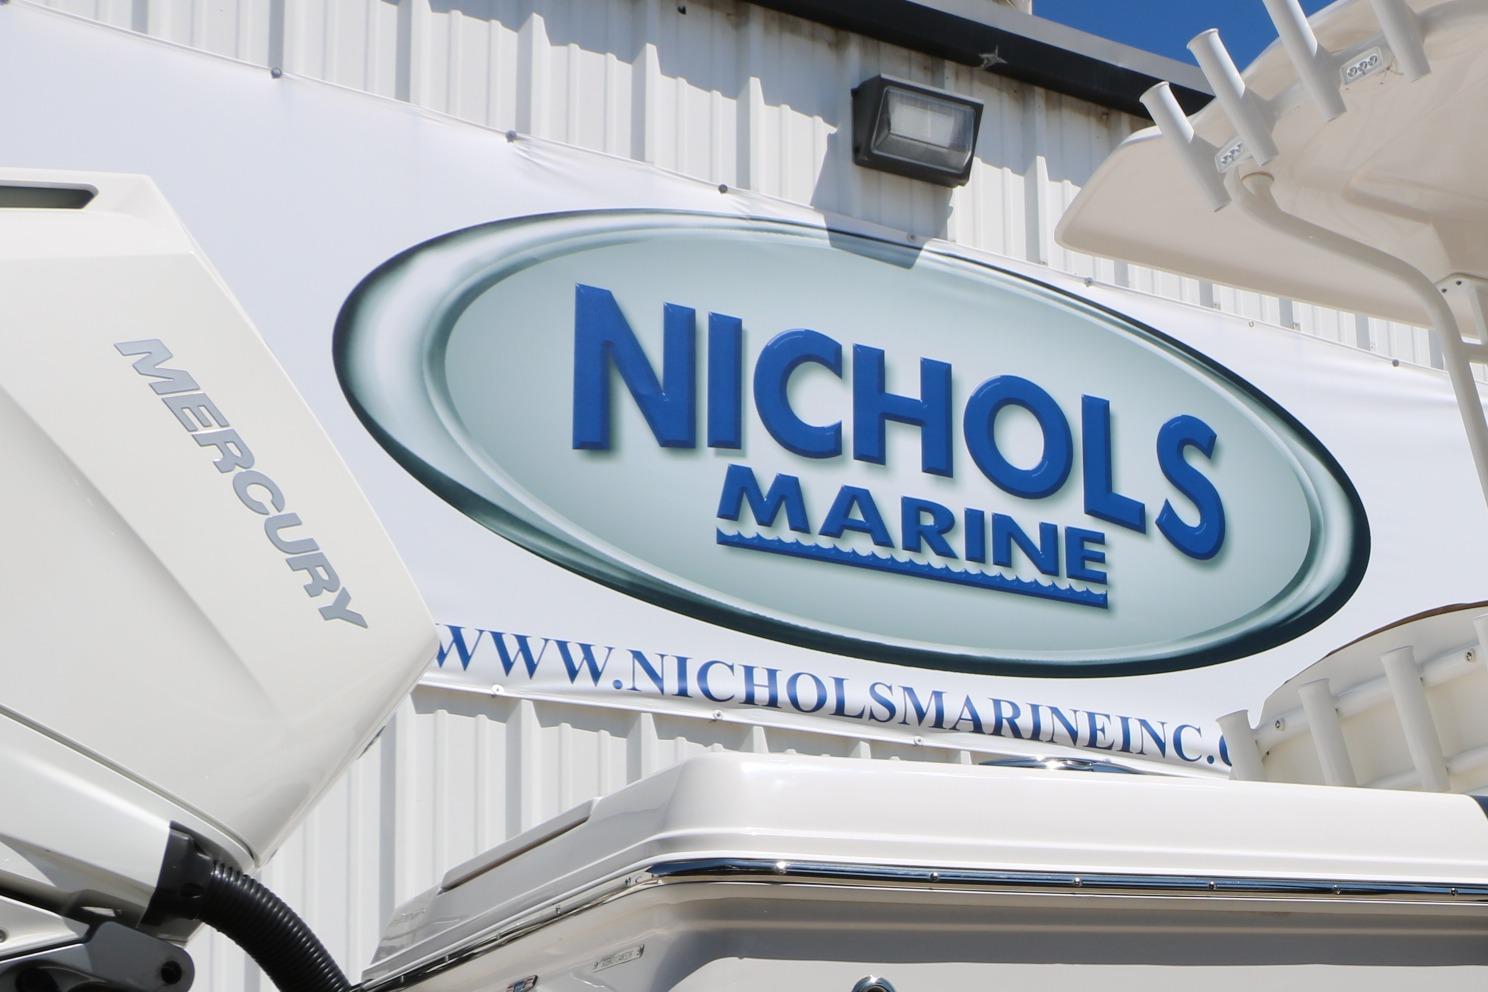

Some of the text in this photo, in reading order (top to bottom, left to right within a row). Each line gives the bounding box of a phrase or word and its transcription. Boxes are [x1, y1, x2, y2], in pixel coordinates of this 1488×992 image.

[113, 338, 369, 629] MERCURY
[572, 283, 1227, 562] NICHOLS
[717, 463, 1110, 586] MARINE
